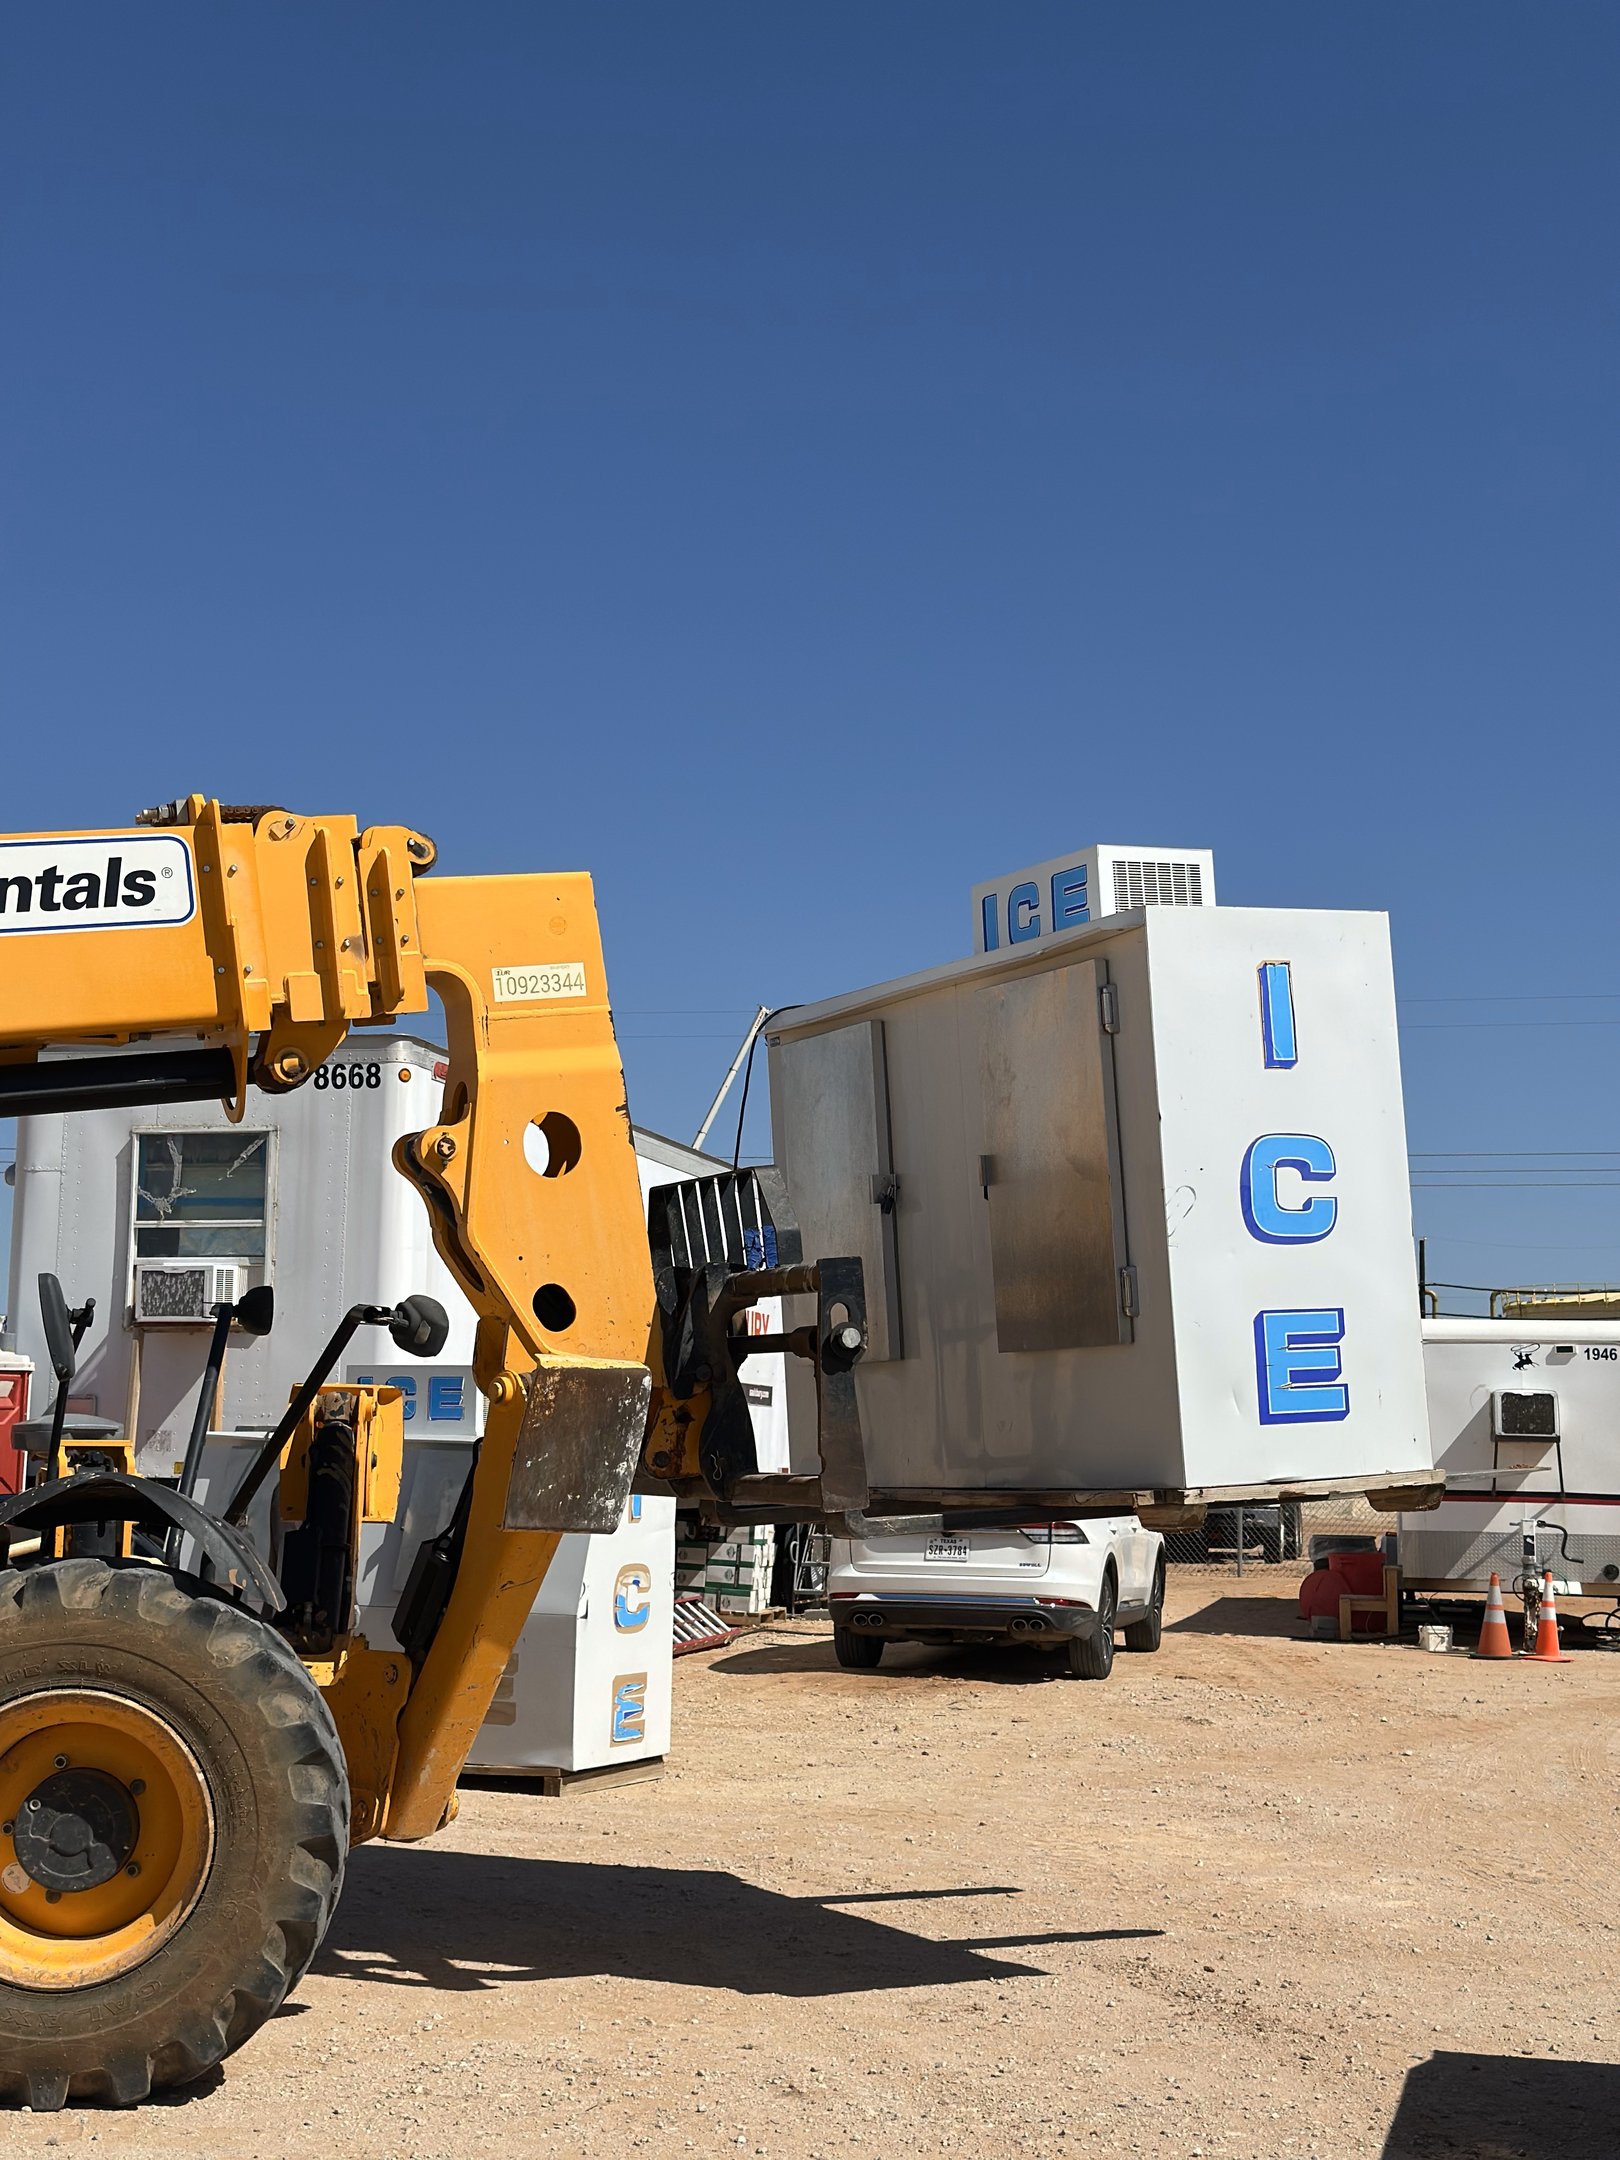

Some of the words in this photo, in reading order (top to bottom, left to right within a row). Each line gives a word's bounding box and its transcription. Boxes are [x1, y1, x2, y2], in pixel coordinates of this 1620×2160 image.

[982, 864, 1090, 952] ICE
[495, 972, 584, 996] 10923344
[314, 1063, 381, 1090] 8668
[1239, 960, 1350, 1425] ICE
[1584, 1347, 1618, 1361] 1946
